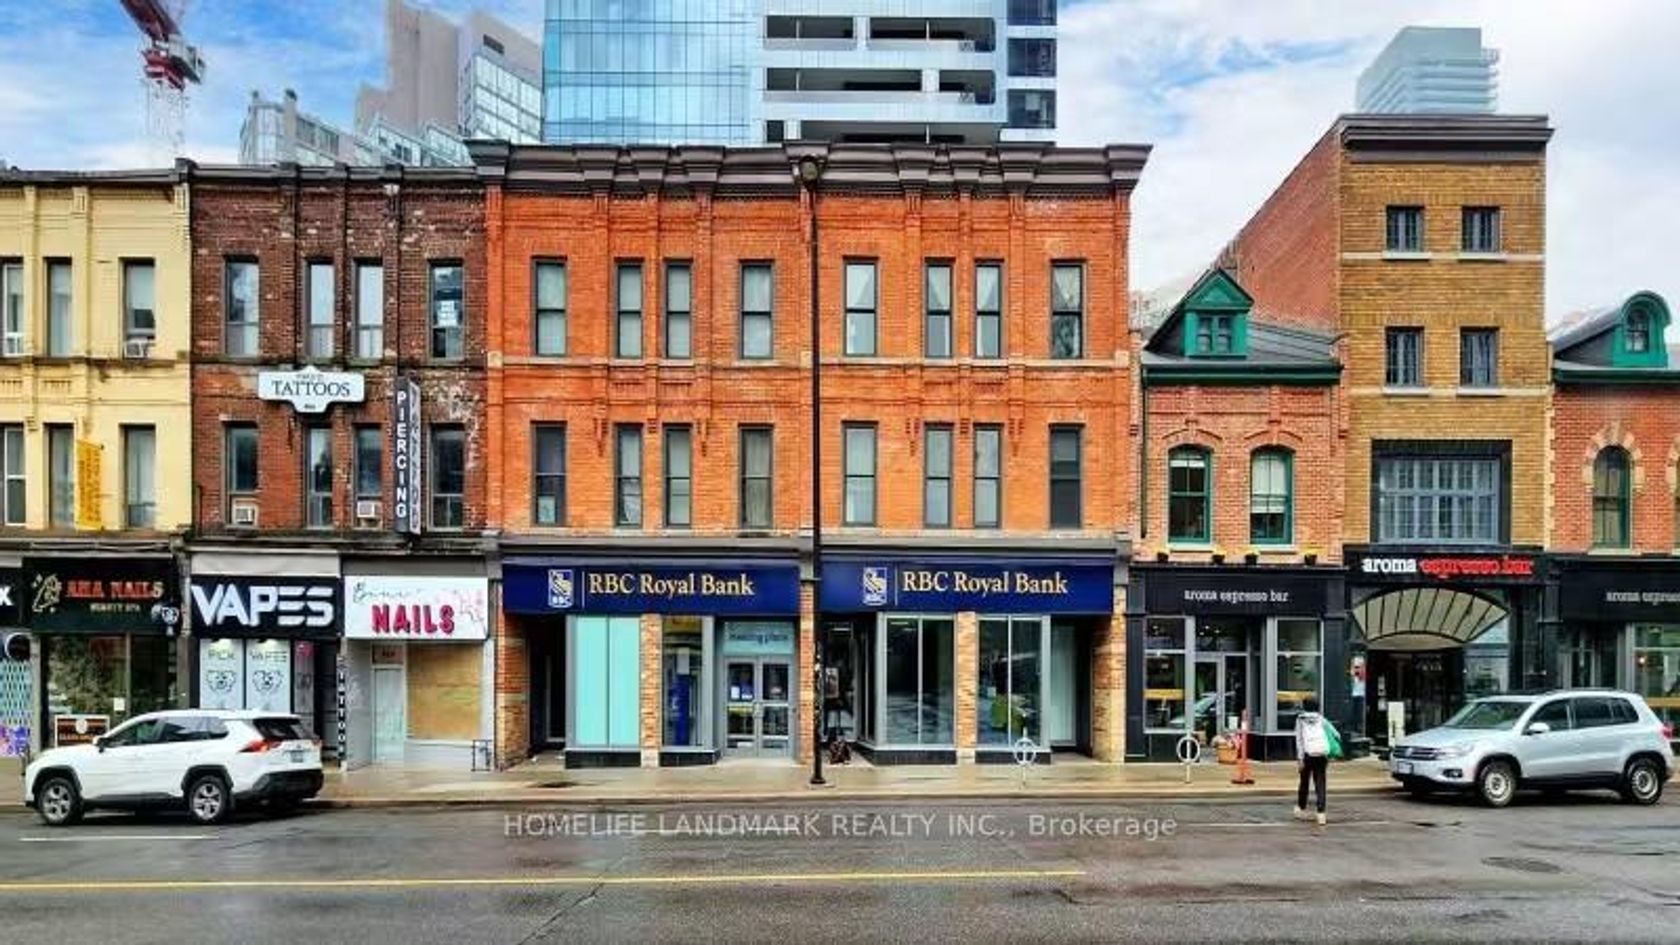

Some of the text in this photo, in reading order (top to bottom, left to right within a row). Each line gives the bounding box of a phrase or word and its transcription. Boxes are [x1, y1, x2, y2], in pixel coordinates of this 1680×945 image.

[272, 380, 350, 397] TATTOOS
[396, 391, 407, 518] PIERCING
[1362, 555, 1534, 579] aroma espresso bar
[110, 581, 164, 599] NAILS
[588, 573, 755, 600] RBC Royal Bank
[903, 571, 1068, 598] RBC Royal Bank
[1184, 589, 1289, 604] aroma espresso bar
[1606, 591, 1640, 602] aroma
[191, 584, 334, 627] VAPES
[372, 604, 455, 634] NAILS
